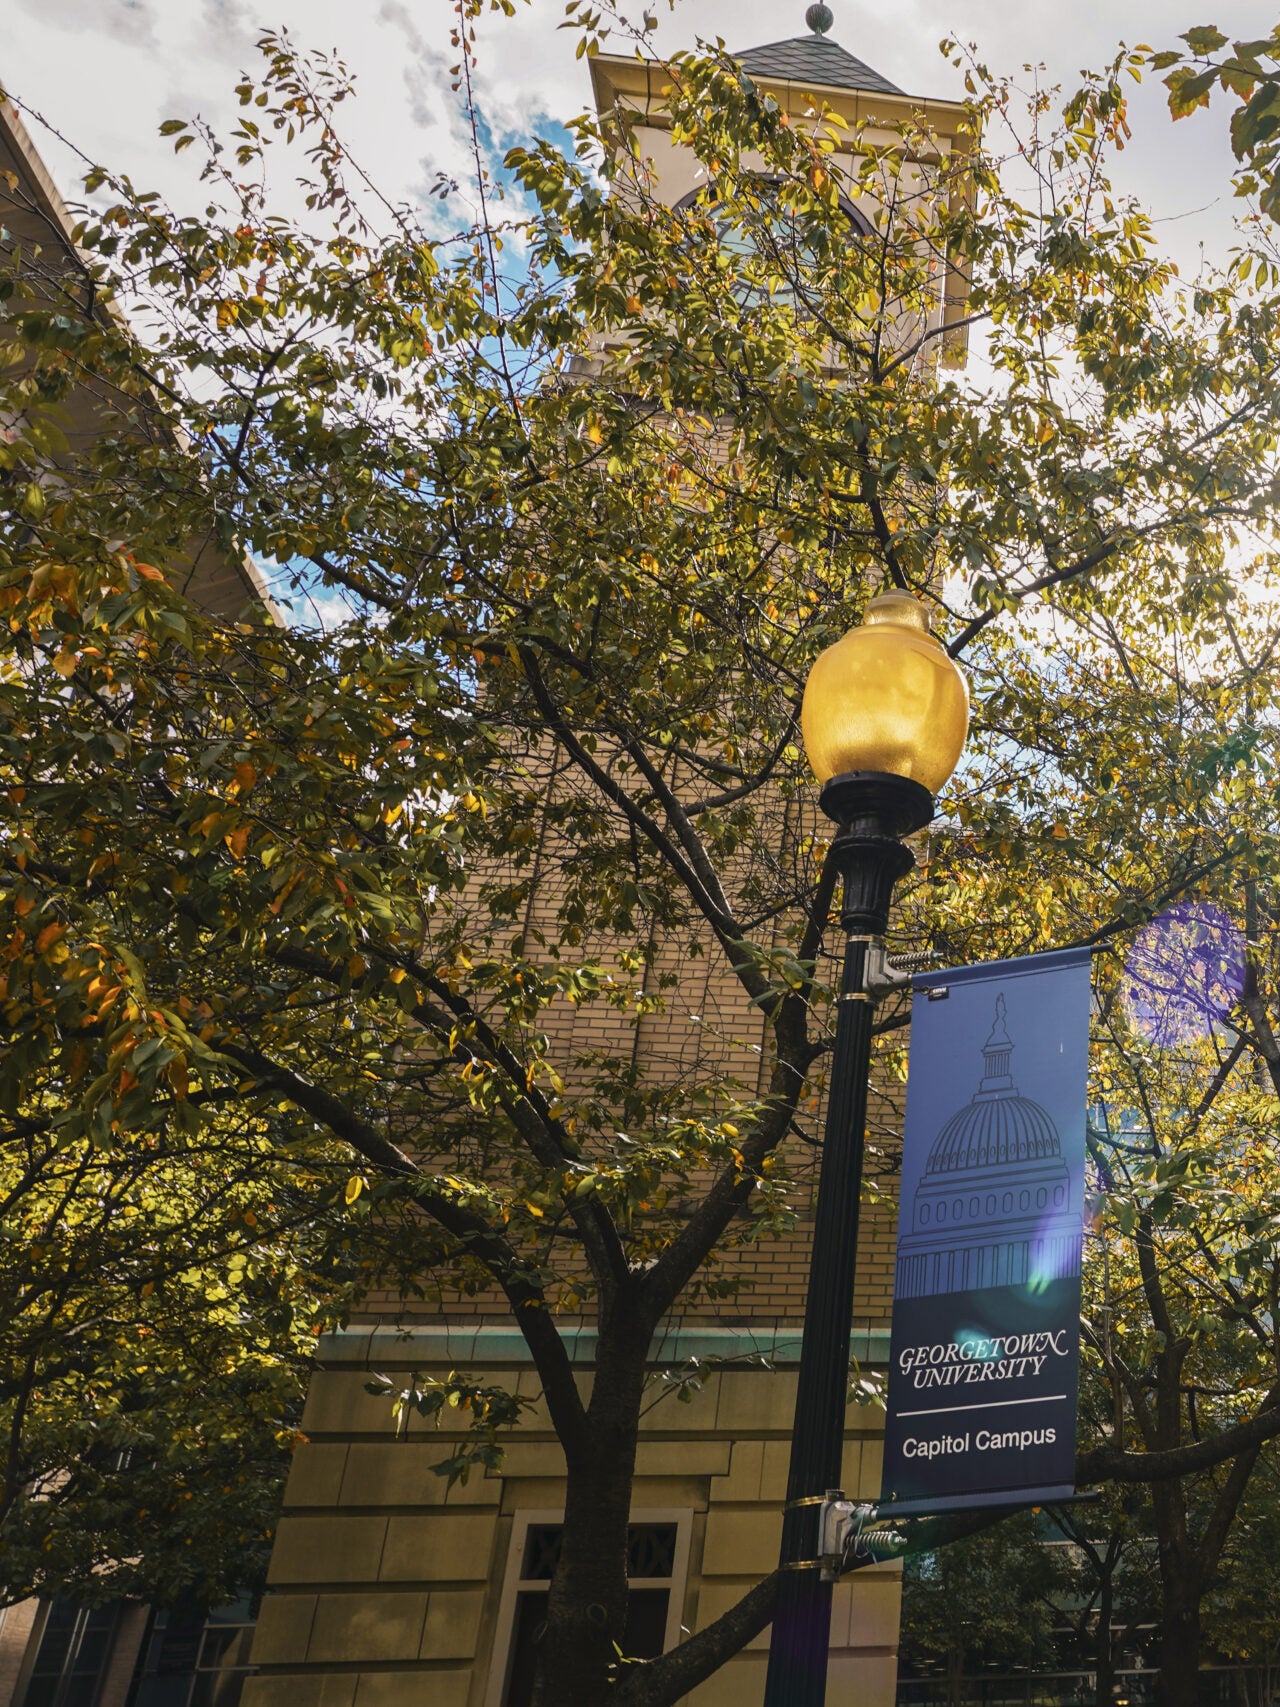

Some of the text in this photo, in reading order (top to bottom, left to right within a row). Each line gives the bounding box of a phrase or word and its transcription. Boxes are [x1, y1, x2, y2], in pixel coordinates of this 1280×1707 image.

[899, 1329, 1069, 1376] GEORGETOWN
[913, 1355, 1048, 1389] UNIVERSITY
[902, 1427, 1056, 1460] Capitol Campus
